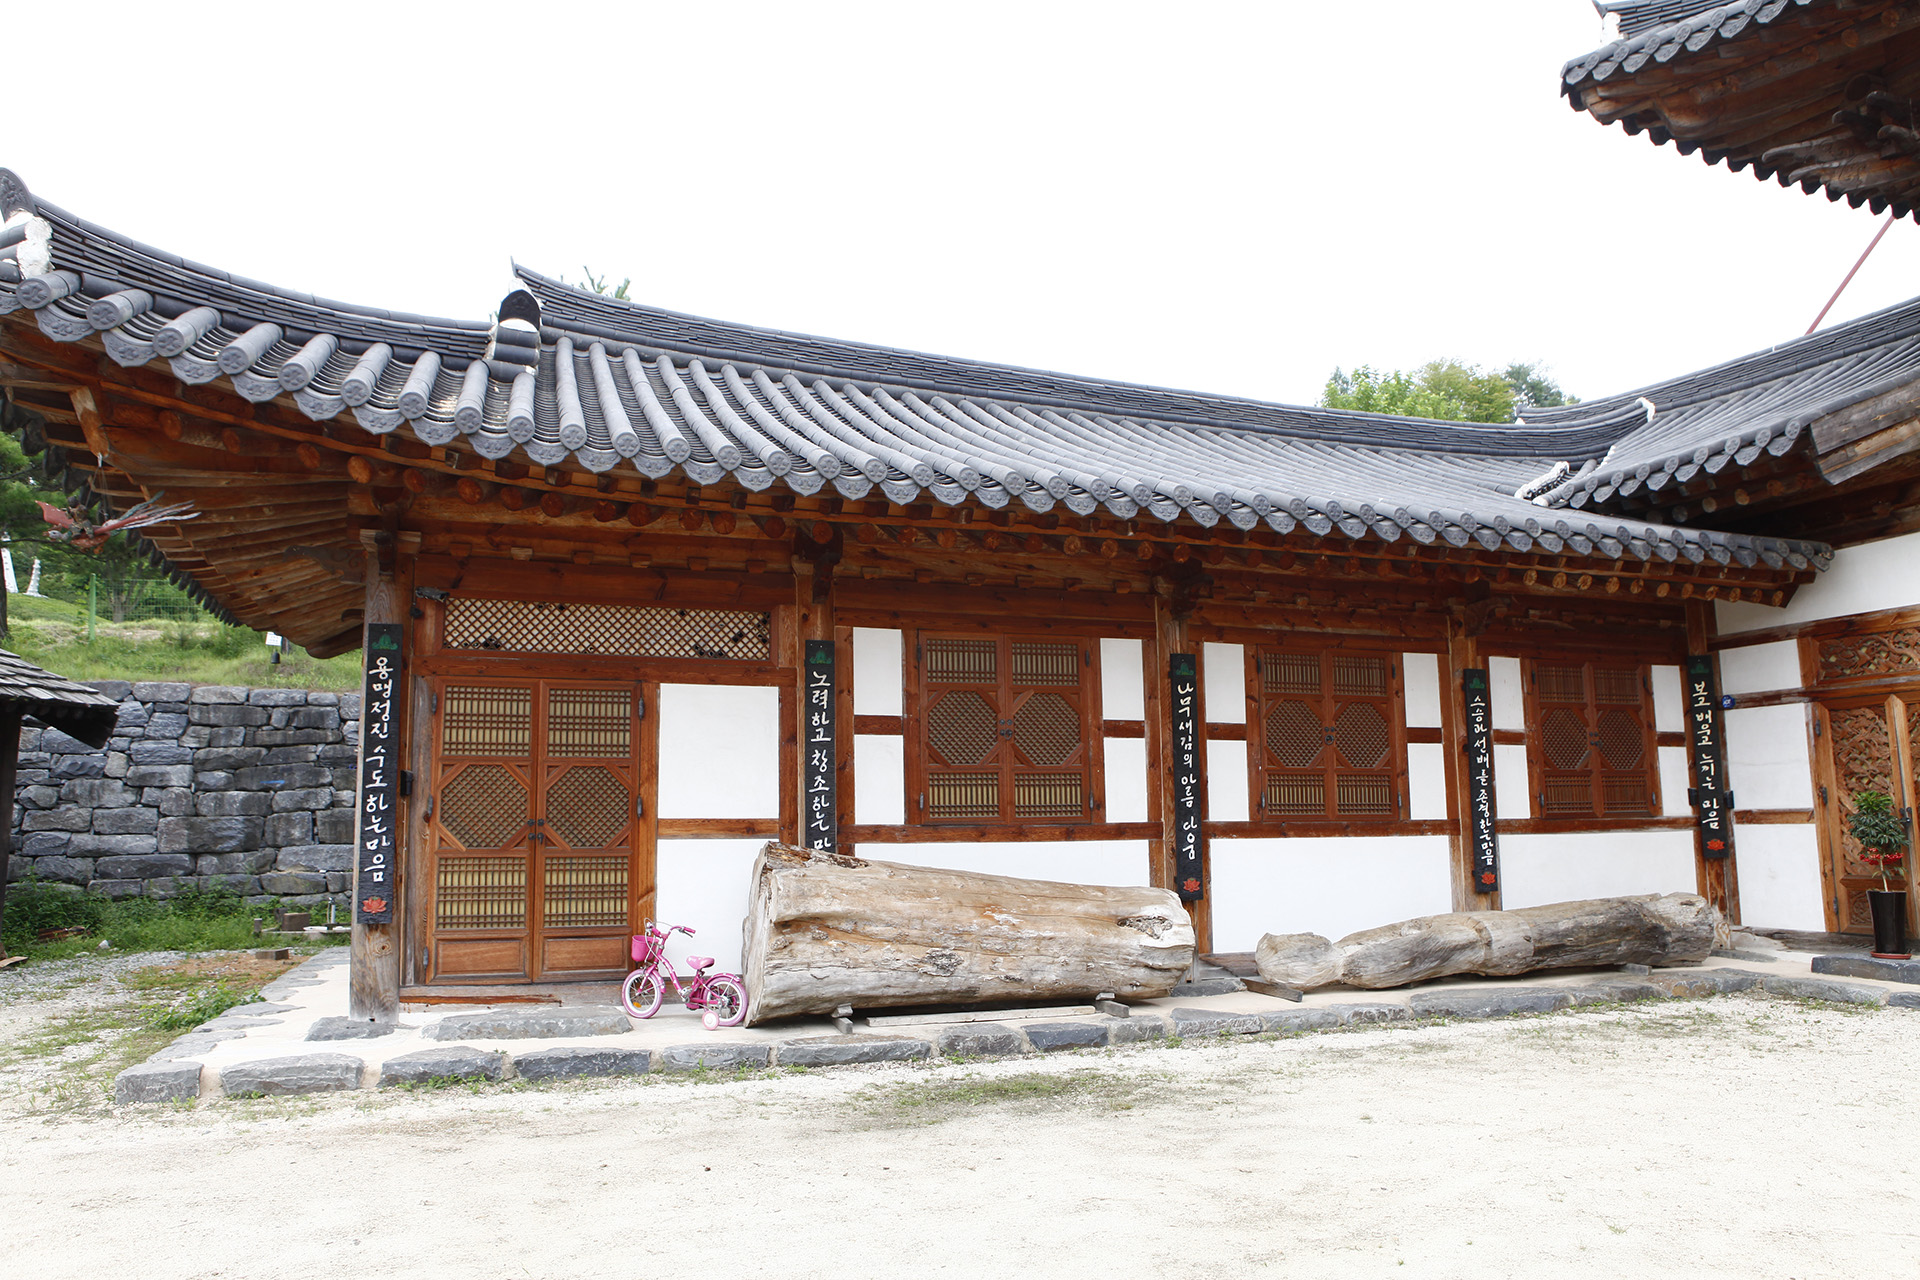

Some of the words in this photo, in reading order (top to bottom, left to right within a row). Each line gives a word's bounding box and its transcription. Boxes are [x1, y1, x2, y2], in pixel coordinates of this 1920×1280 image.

[809, 671, 832, 742] 노력하고
[1470, 695, 1488, 734] 스승과
[1692, 681, 1709, 707] 보고
[1177, 682, 1194, 769] 나무새김의
[1696, 709, 1713, 746] 배우고
[1475, 736, 1490, 786] 선배를
[1699, 753, 1716, 790] 느끼는
[365, 745, 389, 834] 수도하는
[808, 749, 830, 832] 창조하는
[1702, 797, 1720, 830] 마음
[364, 835, 391, 883] 마음
